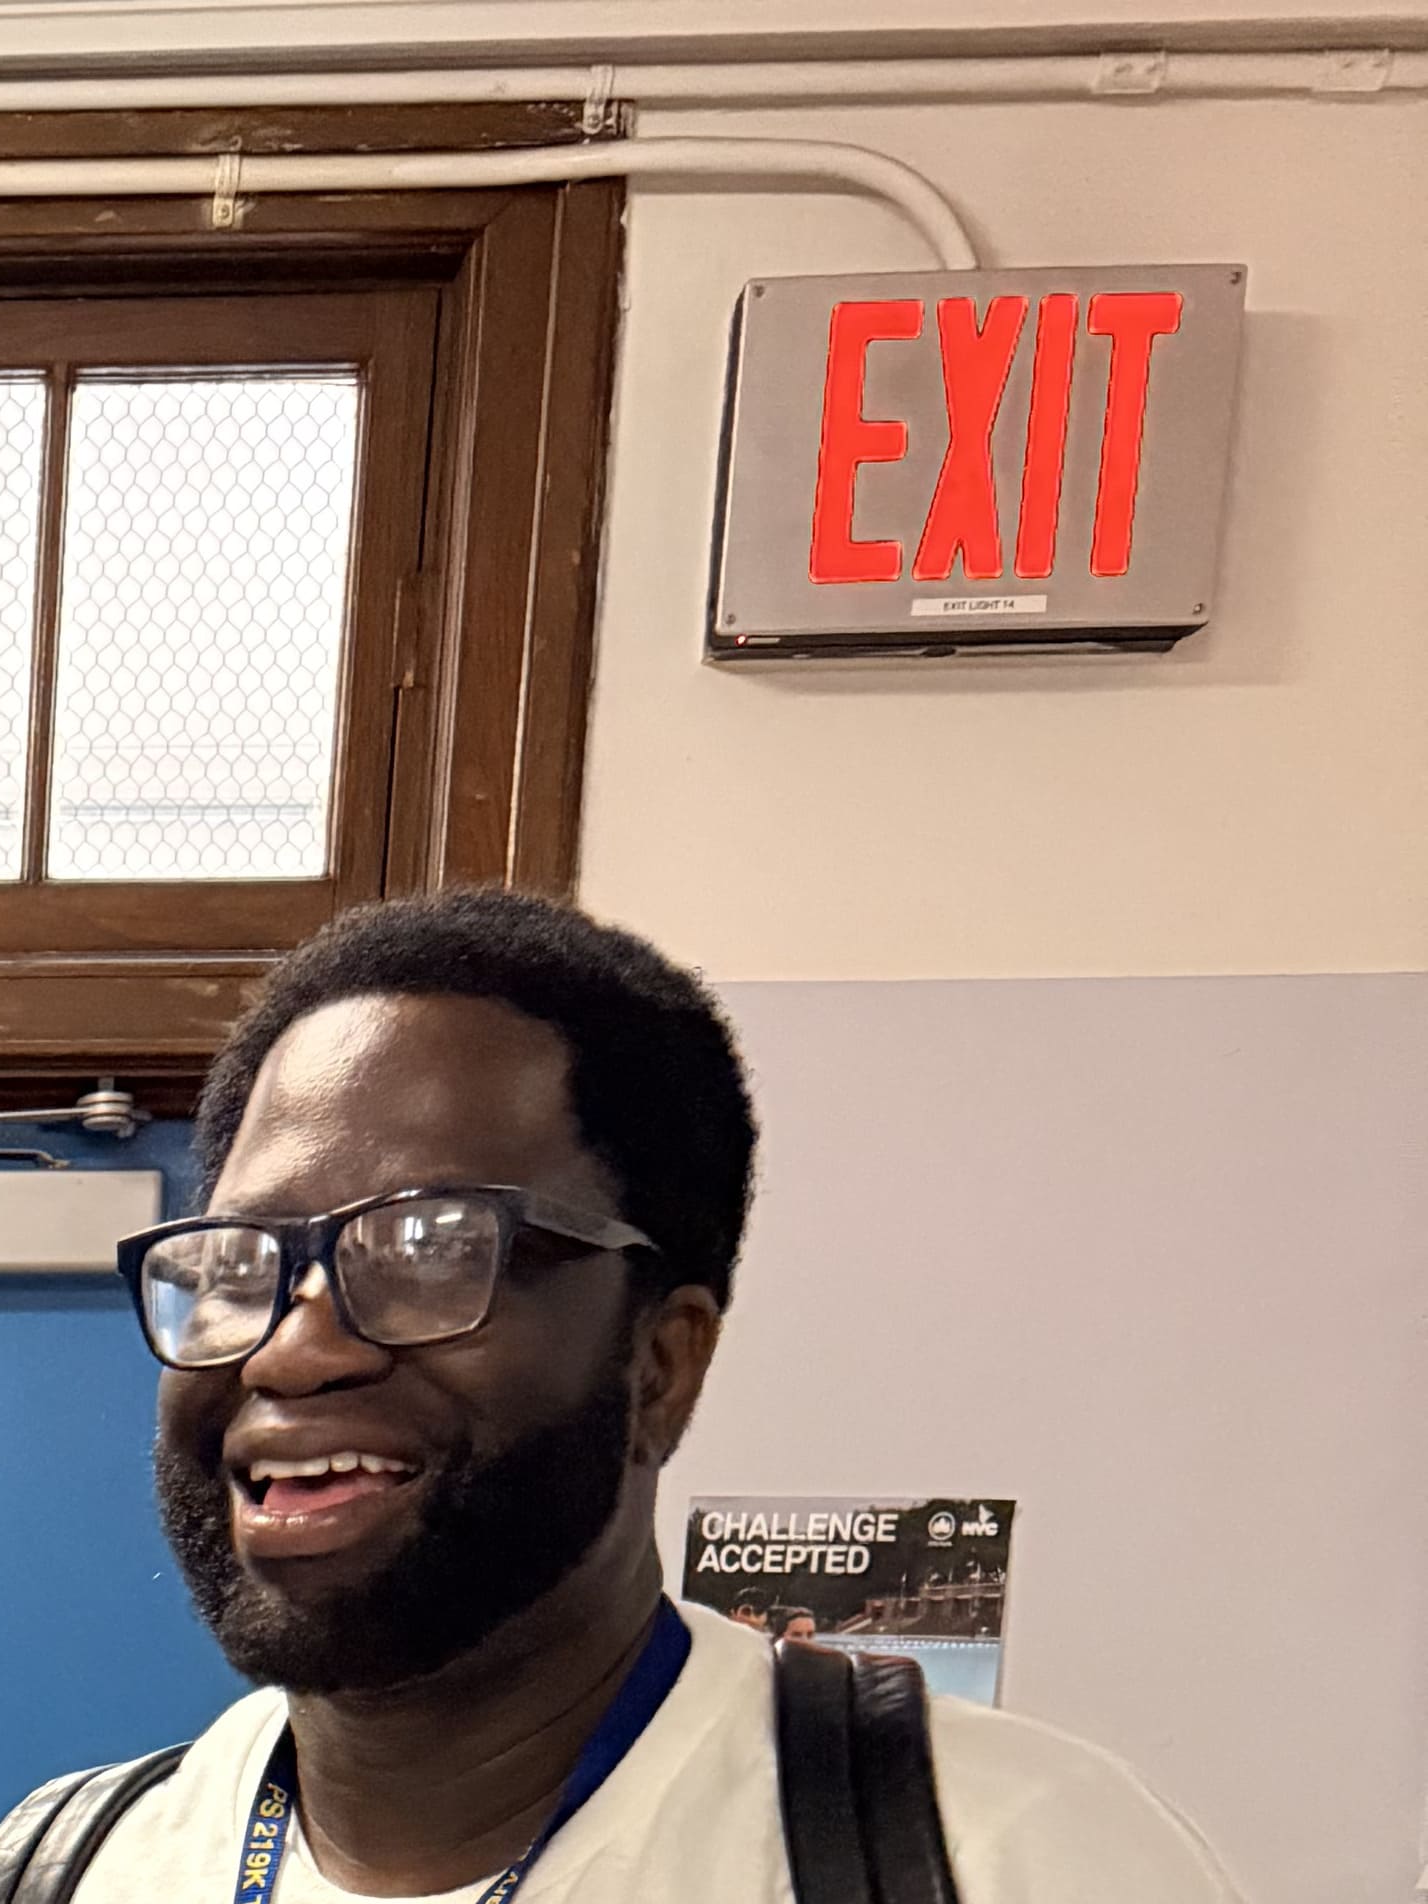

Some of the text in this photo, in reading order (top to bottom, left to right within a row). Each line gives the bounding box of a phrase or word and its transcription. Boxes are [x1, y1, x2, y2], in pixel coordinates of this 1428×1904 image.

[808, 292, 1183, 585] EXIT
[969, 600, 1000, 610] LIGHT
[701, 1511, 899, 1543] CHALLENGE
[696, 1543, 871, 1575] ACCEPTED
[259, 1782, 289, 1819] PS
[241, 1822, 279, 1889] 219K
